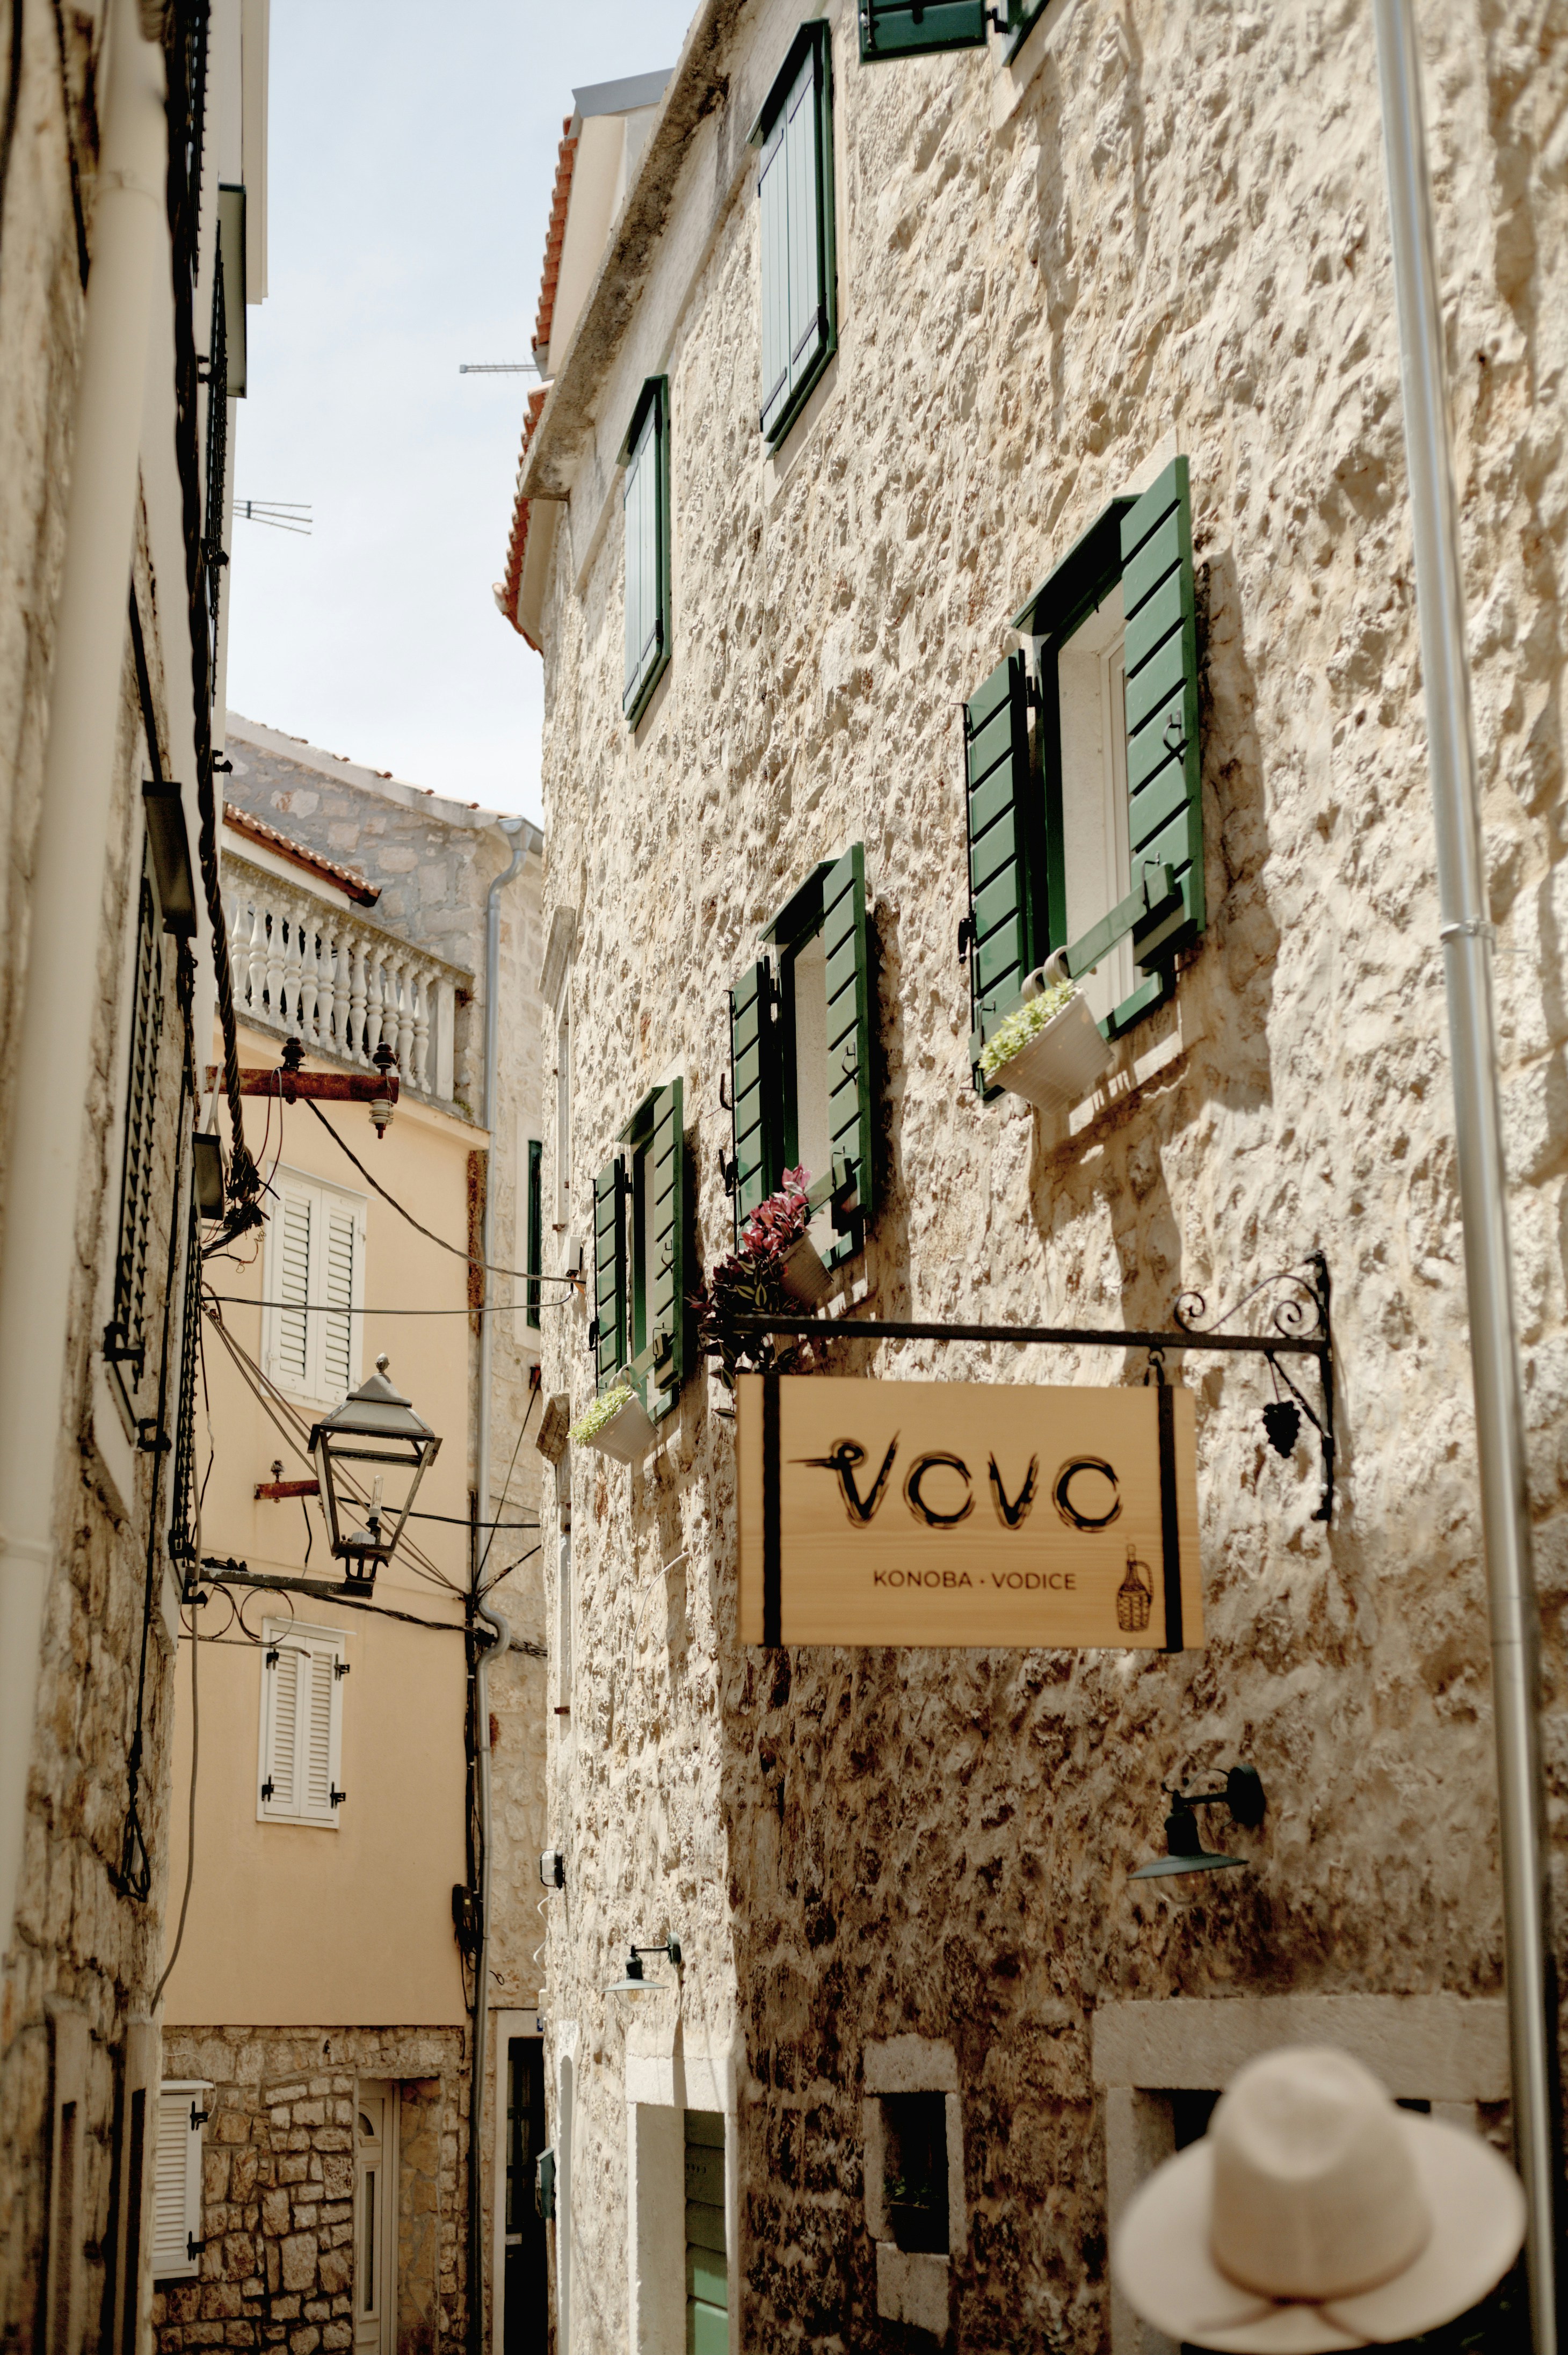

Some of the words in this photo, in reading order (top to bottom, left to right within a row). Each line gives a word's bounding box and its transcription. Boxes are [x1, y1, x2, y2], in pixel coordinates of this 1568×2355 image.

[787, 1429, 1123, 1533] VOVO
[873, 1569, 973, 1588] KONOBA
[991, 1572, 1077, 1590] VODICE
